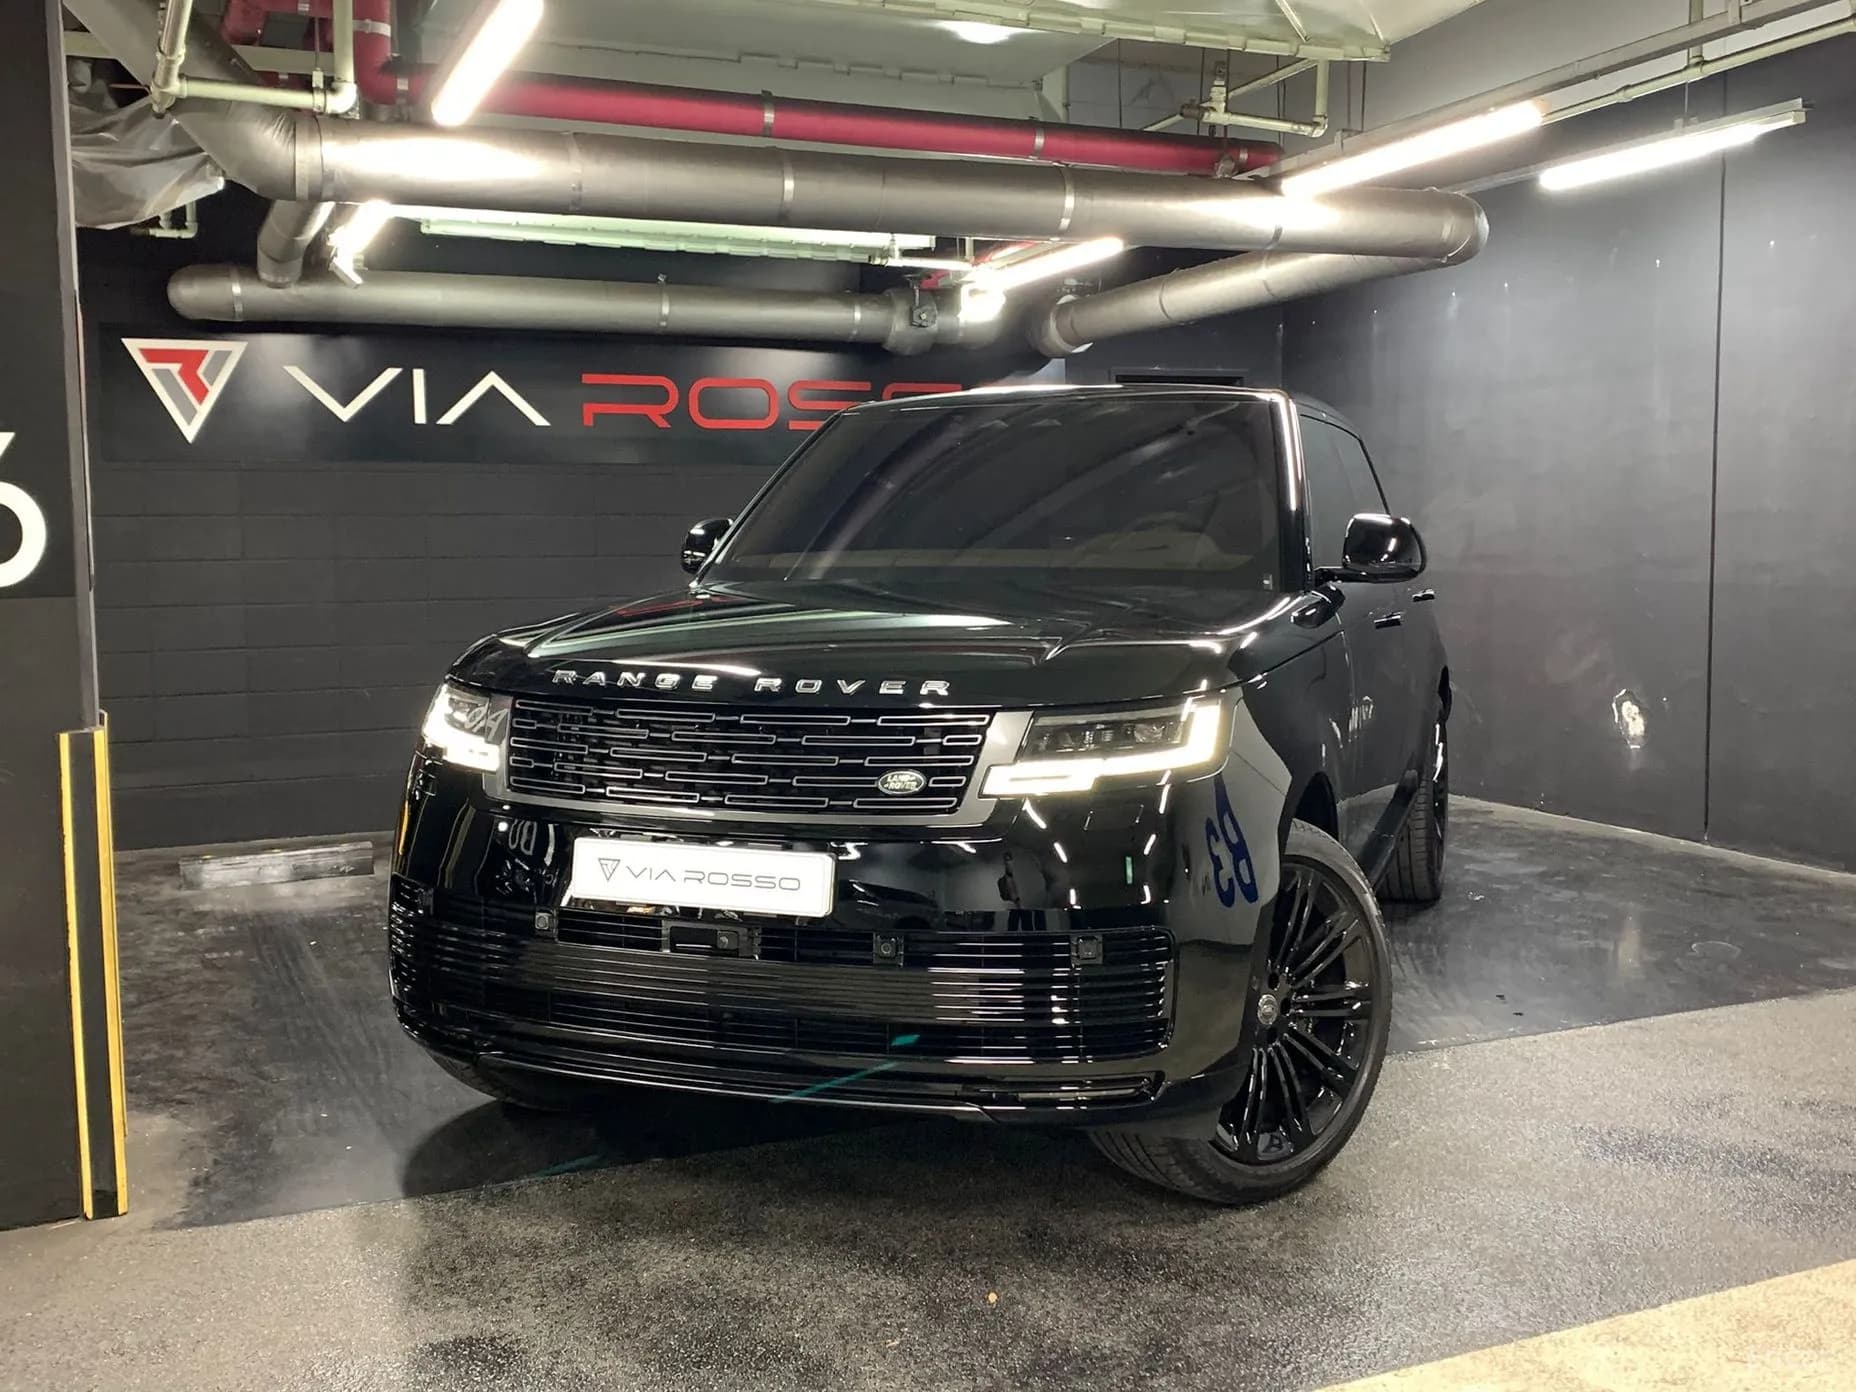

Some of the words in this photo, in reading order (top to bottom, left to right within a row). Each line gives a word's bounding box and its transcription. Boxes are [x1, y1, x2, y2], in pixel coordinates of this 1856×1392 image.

[283, 366, 551, 426] VIA
[552, 670, 718, 691] RANGE
[754, 677, 951, 696] ROVER
[626, 865, 676, 882] VIA
[684, 869, 801, 891] ROSSO
